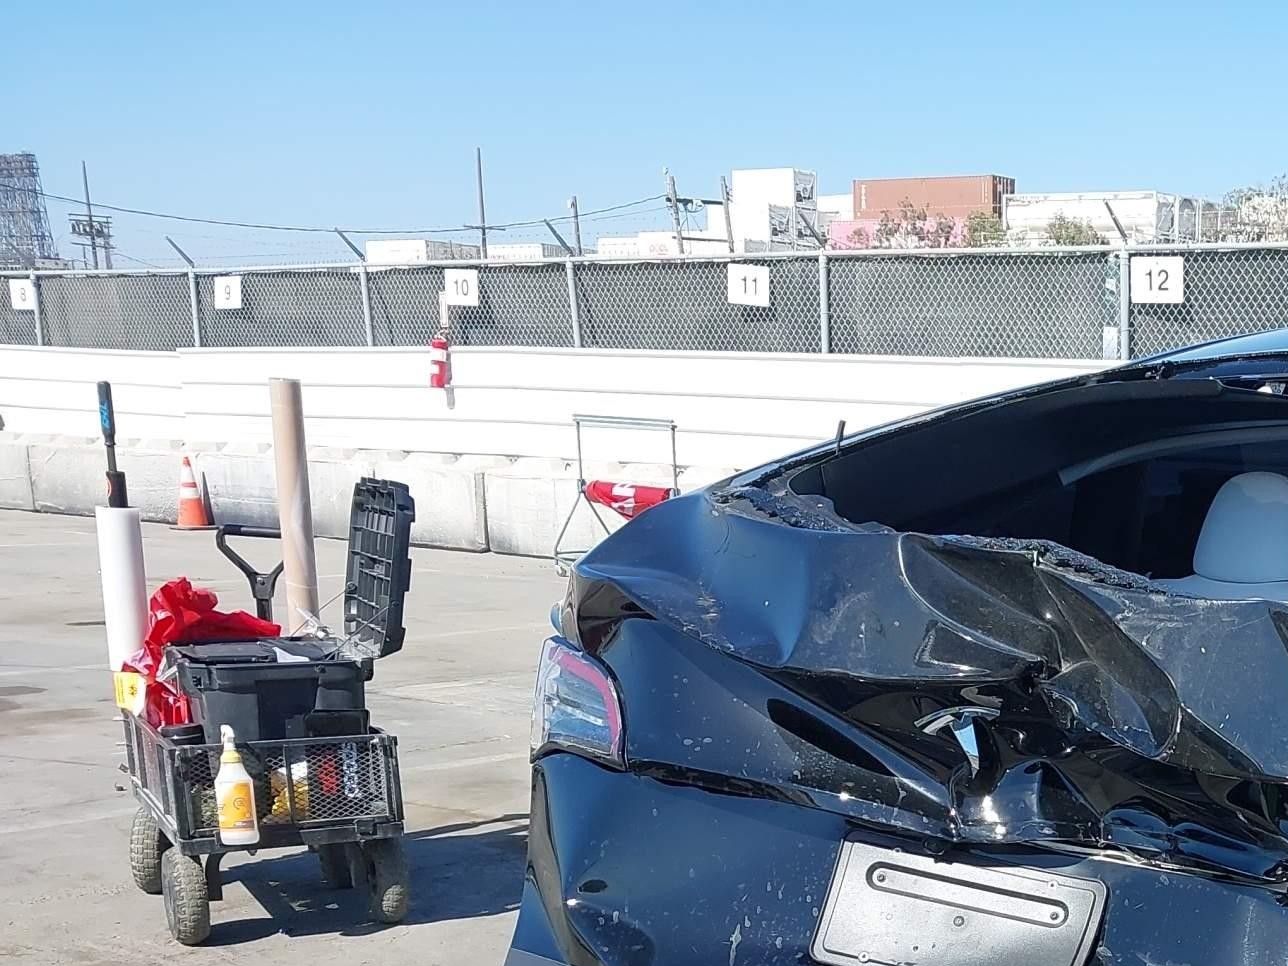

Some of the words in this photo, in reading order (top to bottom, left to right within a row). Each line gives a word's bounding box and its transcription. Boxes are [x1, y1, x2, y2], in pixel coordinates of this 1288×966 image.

[453, 279, 469, 296] 10
[740, 275, 757, 296] 11
[1145, 269, 1169, 290] 12
[224, 284, 231, 301] 9
